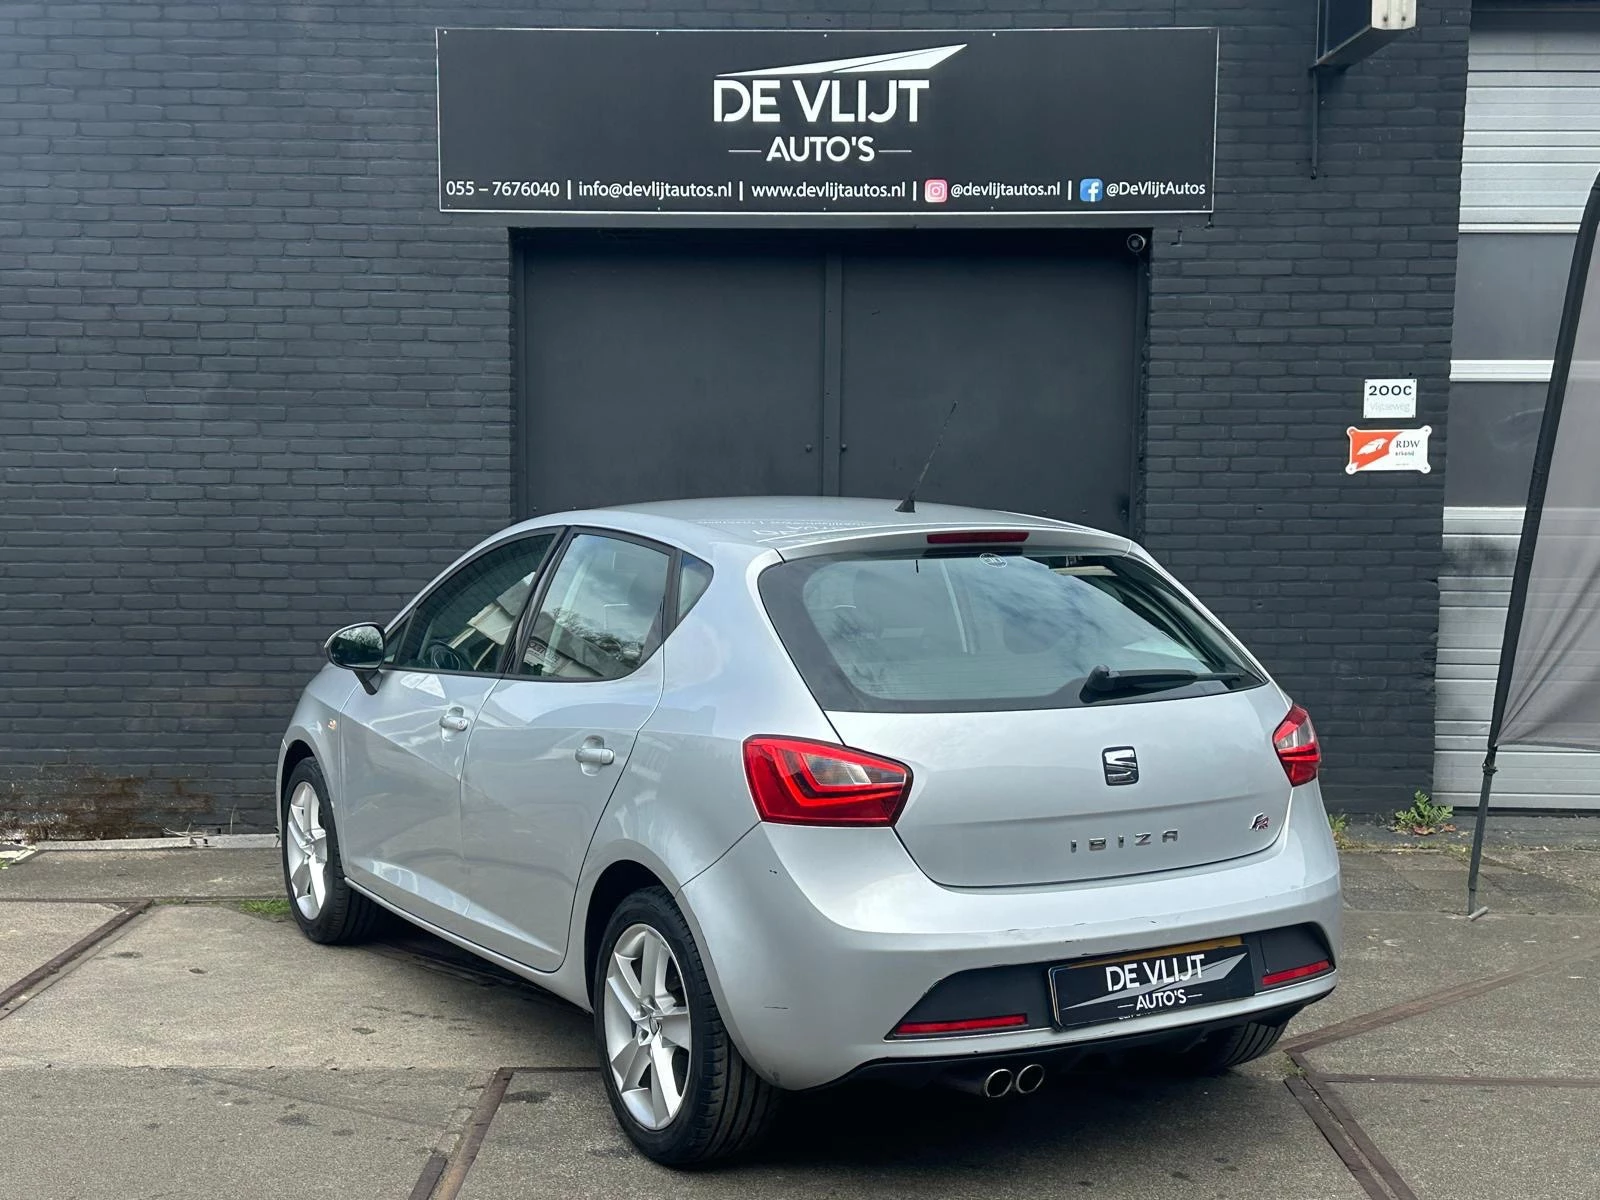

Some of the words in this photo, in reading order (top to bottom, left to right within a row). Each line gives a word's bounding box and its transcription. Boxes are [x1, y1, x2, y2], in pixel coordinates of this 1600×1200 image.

[713, 79, 781, 122] DE
[792, 79, 930, 123] VLIJT
[766, 135, 875, 162] AUTO'S
[446, 181, 475, 196] 055
[492, 181, 560, 197] 7676040
[578, 181, 732, 200] info@devlijtautos.nl
[751, 181, 906, 201] www.devlijtautos.nl
[950, 181, 1061, 199] @devlijtautos.nl
[1106, 181, 1206, 198] @DeVlijtAutos
[1395, 439, 1421, 449] RDW
[1070, 829, 1179, 853] IBIZA
[1105, 962, 1140, 992] DE
[1143, 953, 1206, 986] VLIJT
[1136, 989, 1188, 1011] AUTO'S
